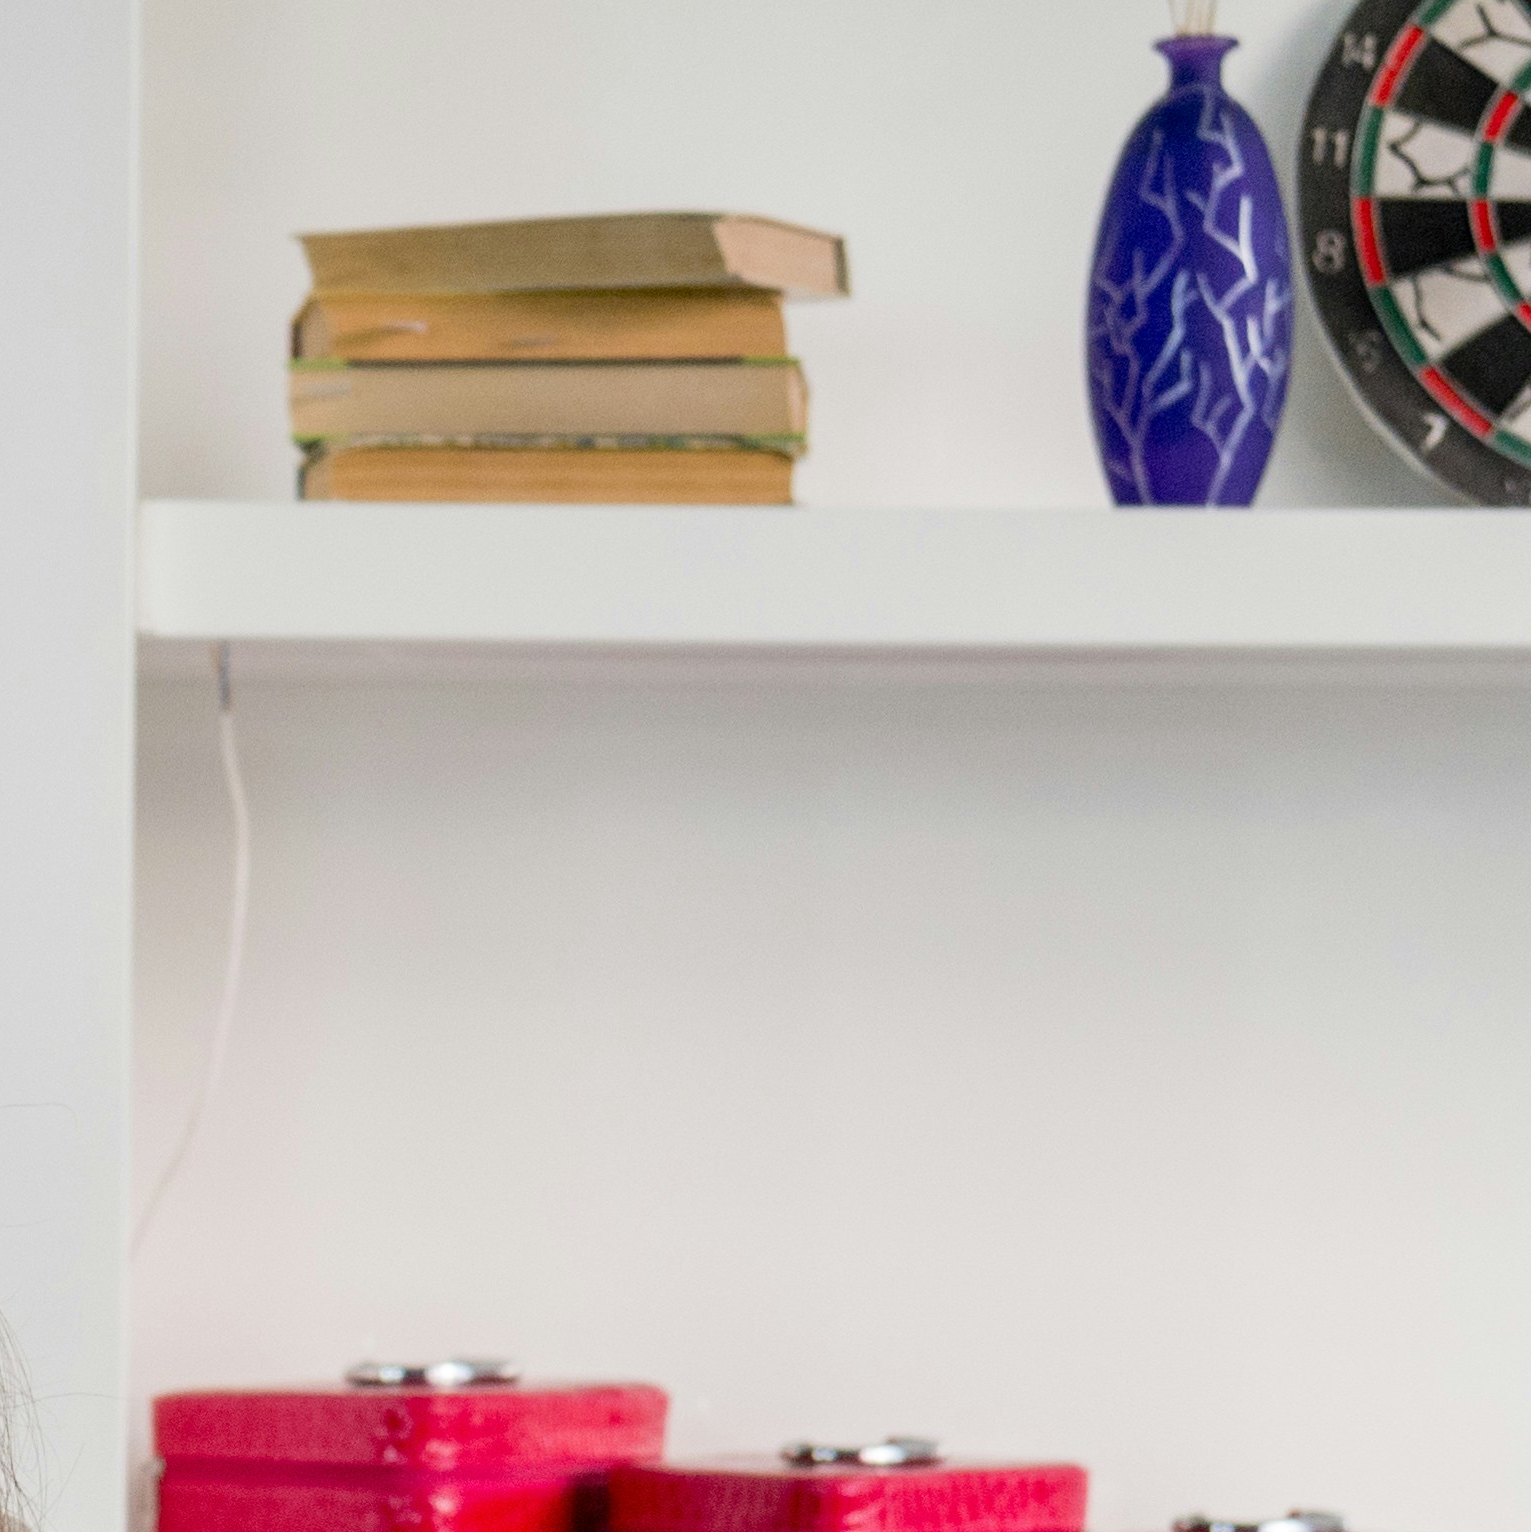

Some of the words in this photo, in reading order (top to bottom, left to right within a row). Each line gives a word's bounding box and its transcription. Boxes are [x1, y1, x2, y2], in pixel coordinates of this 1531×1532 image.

[1341, 33, 1376, 69] 14
[1312, 127, 1348, 169] 11
[1313, 230, 1345, 273] 8
[1422, 412, 1448, 453] 7
